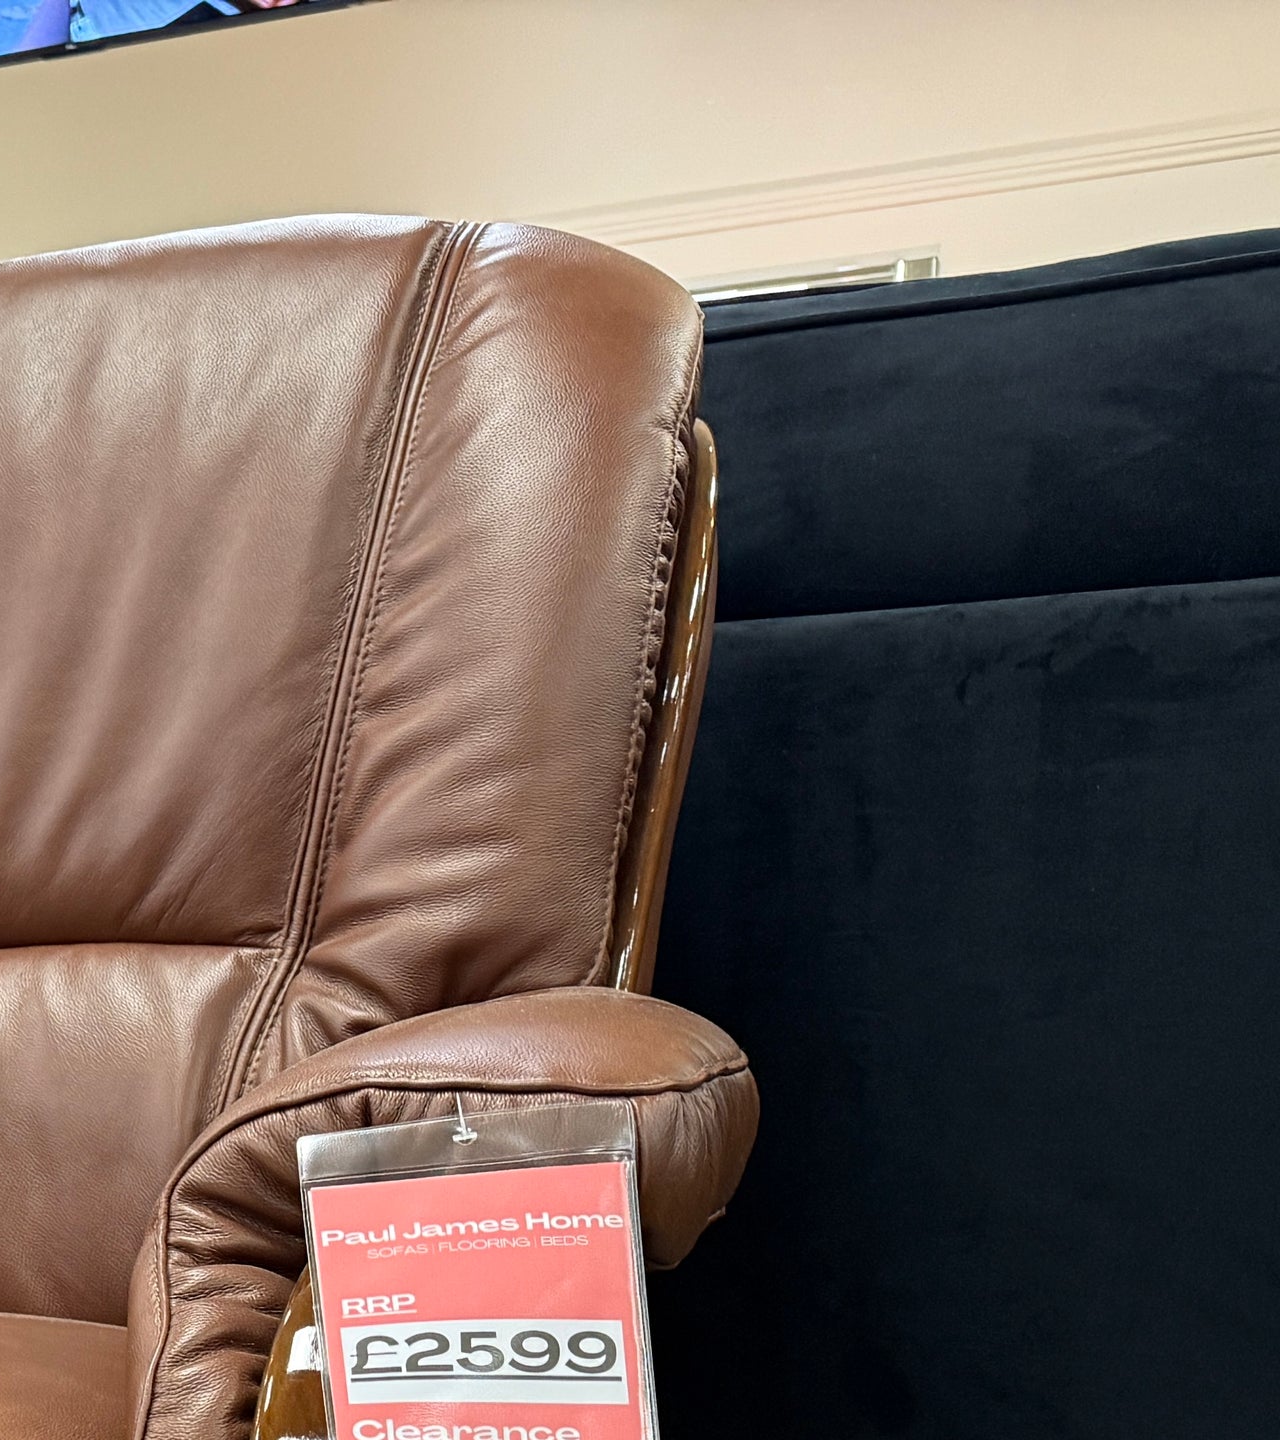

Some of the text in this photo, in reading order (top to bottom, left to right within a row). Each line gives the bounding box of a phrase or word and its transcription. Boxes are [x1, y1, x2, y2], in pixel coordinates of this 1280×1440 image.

[321, 1211, 624, 1247] Paul James Home
[367, 1234, 589, 1259] SOFAS FLOORING BEDS
[341, 1293, 416, 1316] RRP
[350, 1331, 617, 1375] £2599
